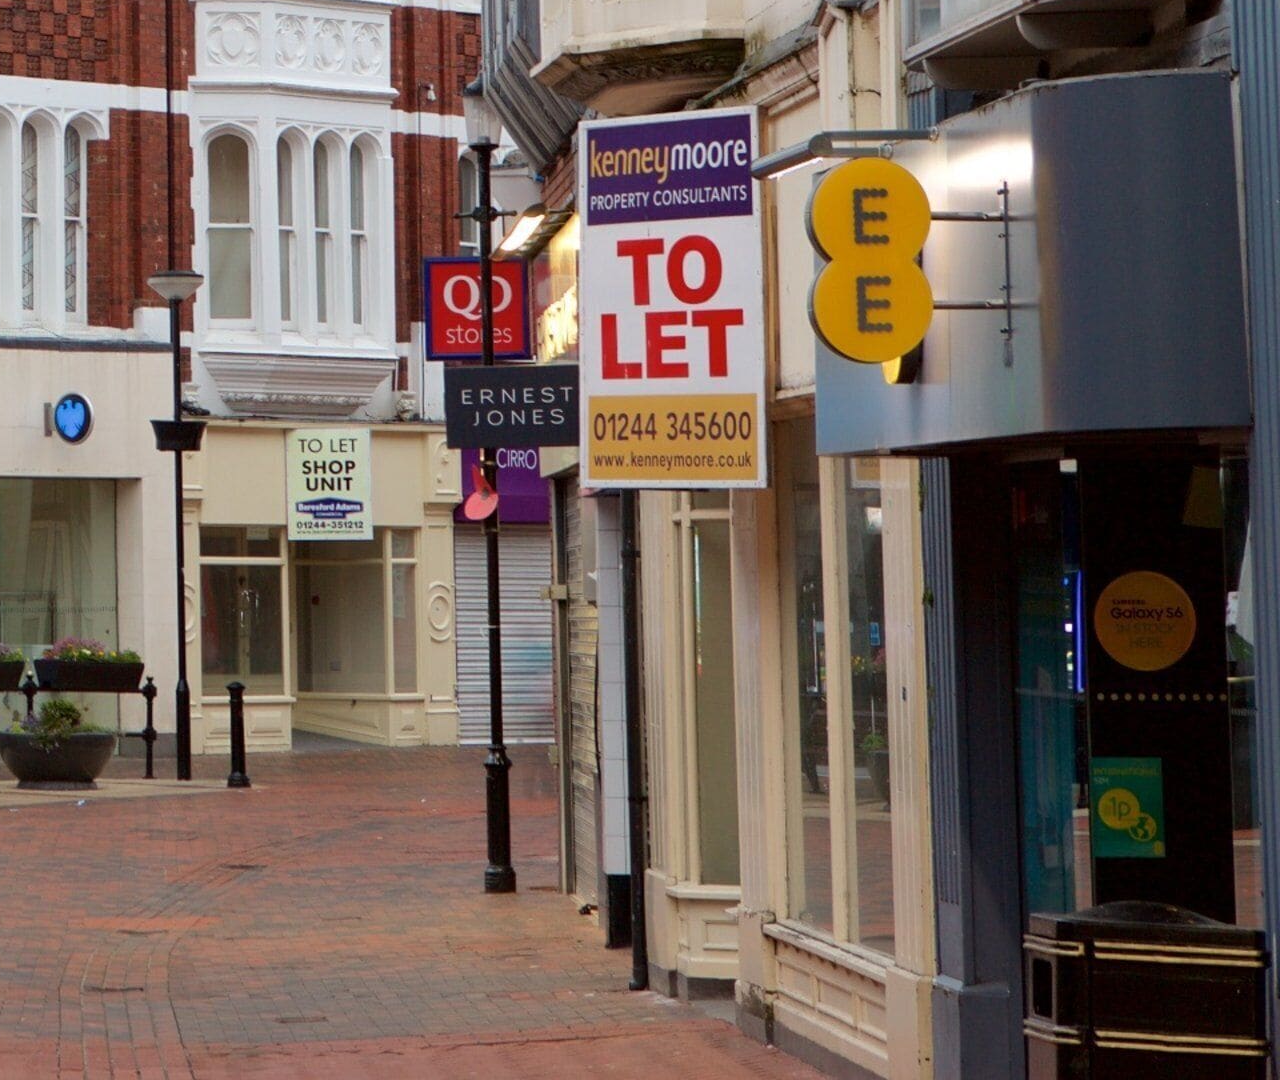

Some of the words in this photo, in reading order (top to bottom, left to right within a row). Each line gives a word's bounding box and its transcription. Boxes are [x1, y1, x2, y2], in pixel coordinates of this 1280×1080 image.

[590, 139, 748, 184] kenneymoore
[590, 191, 650, 211] PROPERTY
[652, 184, 748, 207] CONSULTANTS
[616, 234, 723, 305] TO
[443, 274, 513, 320] QD
[445, 325, 513, 344] stoes
[601, 308, 744, 380] LET
[461, 386, 574, 406] ERNEST
[472, 408, 566, 426] JONES
[594, 412, 658, 441] 01244
[665, 411, 752, 441] 345600
[297, 438, 323, 453] TO
[330, 438, 358, 453] LET
[301, 460, 356, 475] SHOP
[496, 447, 538, 470] CIRRO
[594, 451, 752, 471] www.kenneymoore.co.uk
[305, 477, 353, 492] UNIT
[296, 520, 364, 529] 01244-351212
[1110, 606, 1164, 621] Galaxy
[1166, 607, 1184, 619] S6
[1109, 796, 1131, 821] 1p
